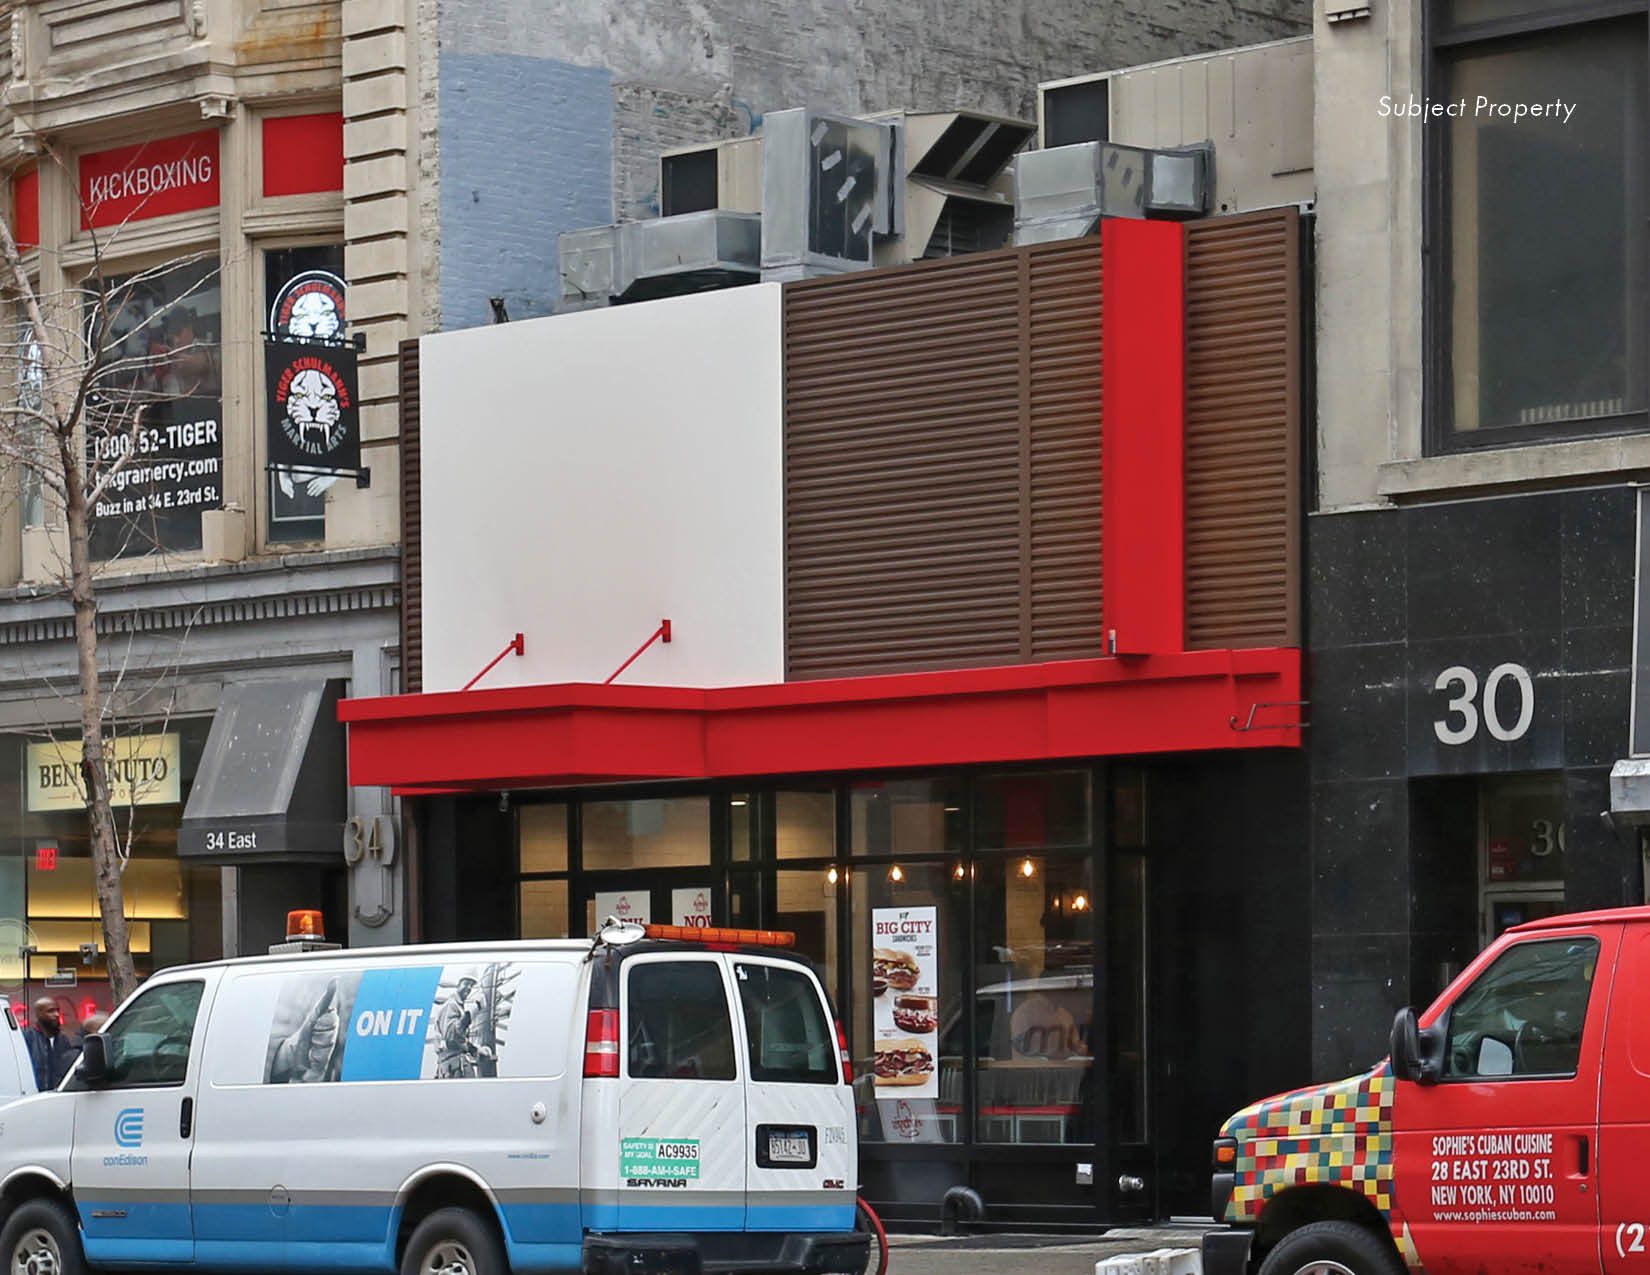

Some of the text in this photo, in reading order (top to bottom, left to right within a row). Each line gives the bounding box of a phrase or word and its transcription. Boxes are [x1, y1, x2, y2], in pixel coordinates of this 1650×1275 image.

[90, 155, 211, 203] KICKBOXING
[276, 367, 295, 402] TIGER
[140, 420, 217, 454] 52-TIGER
[281, 418, 347, 455] MARTIAL ARTS
[96, 502, 121, 517] Buzz
[123, 498, 133, 513] in
[135, 496, 146, 511] at
[164, 492, 175, 508] E.
[177, 487, 202, 506] 23rd
[204, 486, 219, 501] St.
[1433, 662, 1535, 746] 30
[39, 756, 168, 788] BENNUTO
[206, 831, 257, 850] 34 East
[347, 817, 384, 863] 34
[876, 920, 932, 935] BIG CITY
[356, 1008, 424, 1036] ON IT
[623, 1142, 646, 1150] SAFETY
[658, 1144, 698, 1159] AC9935
[1432, 1133, 1553, 1156] SOPHIE'S CUBAN CUISINE
[1431, 1158, 1553, 1181] 28 EAST 23RD ST.
[626, 1179, 688, 1188] SAVANA
[823, 1179, 844, 1189] GMC
[1431, 1184, 1554, 1207] NEW YORK, NY 10010
[1433, 1207, 1556, 1224] www.sophiescuban.com
